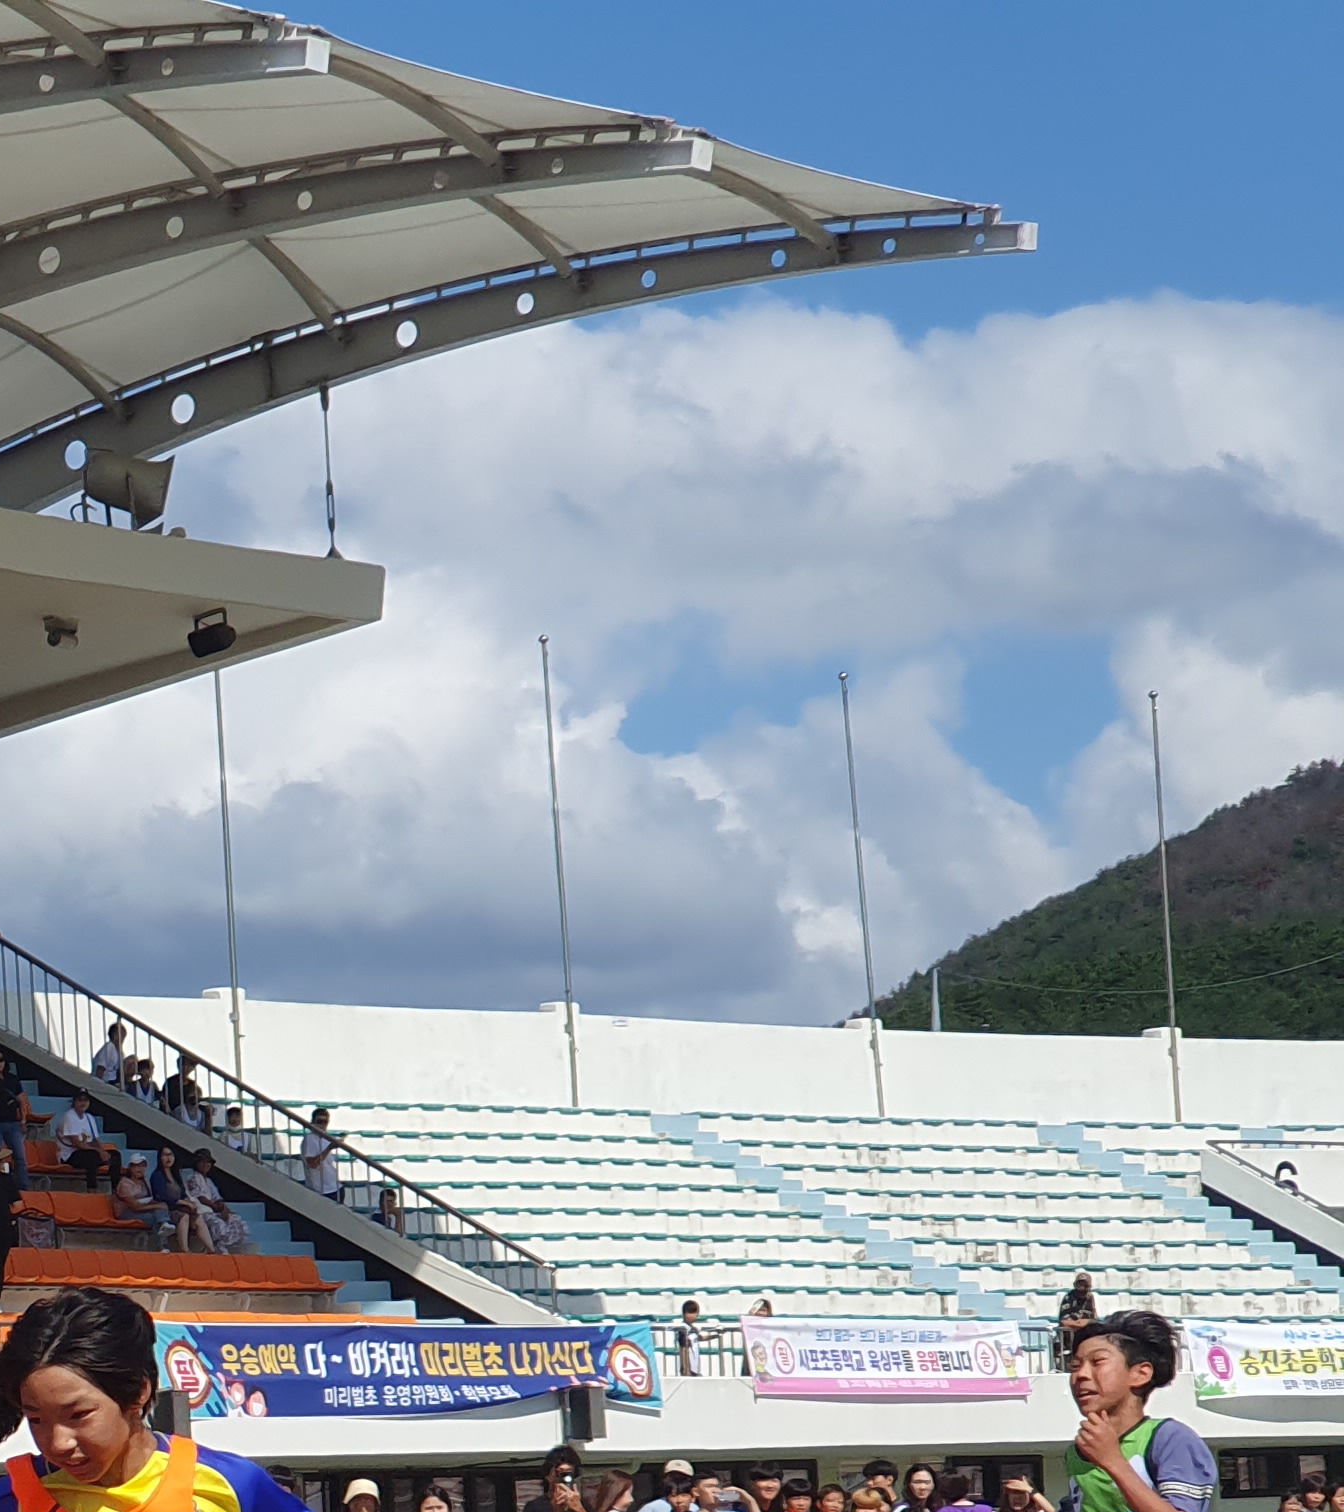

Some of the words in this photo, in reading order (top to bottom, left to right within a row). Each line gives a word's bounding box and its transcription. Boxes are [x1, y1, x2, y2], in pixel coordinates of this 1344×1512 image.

[220, 1343, 301, 1376] 우승예약
[347, 1340, 420, 1379] 비켜라!
[420, 1341, 509, 1377] 미리벌초
[508, 1341, 596, 1376] 나가신다
[798, 1348, 867, 1372] 사포초등학교
[867, 1349, 915, 1373] 육상부를
[916, 1350, 974, 1373] 응원합니다
[323, 1384, 379, 1408] 미리벌초
